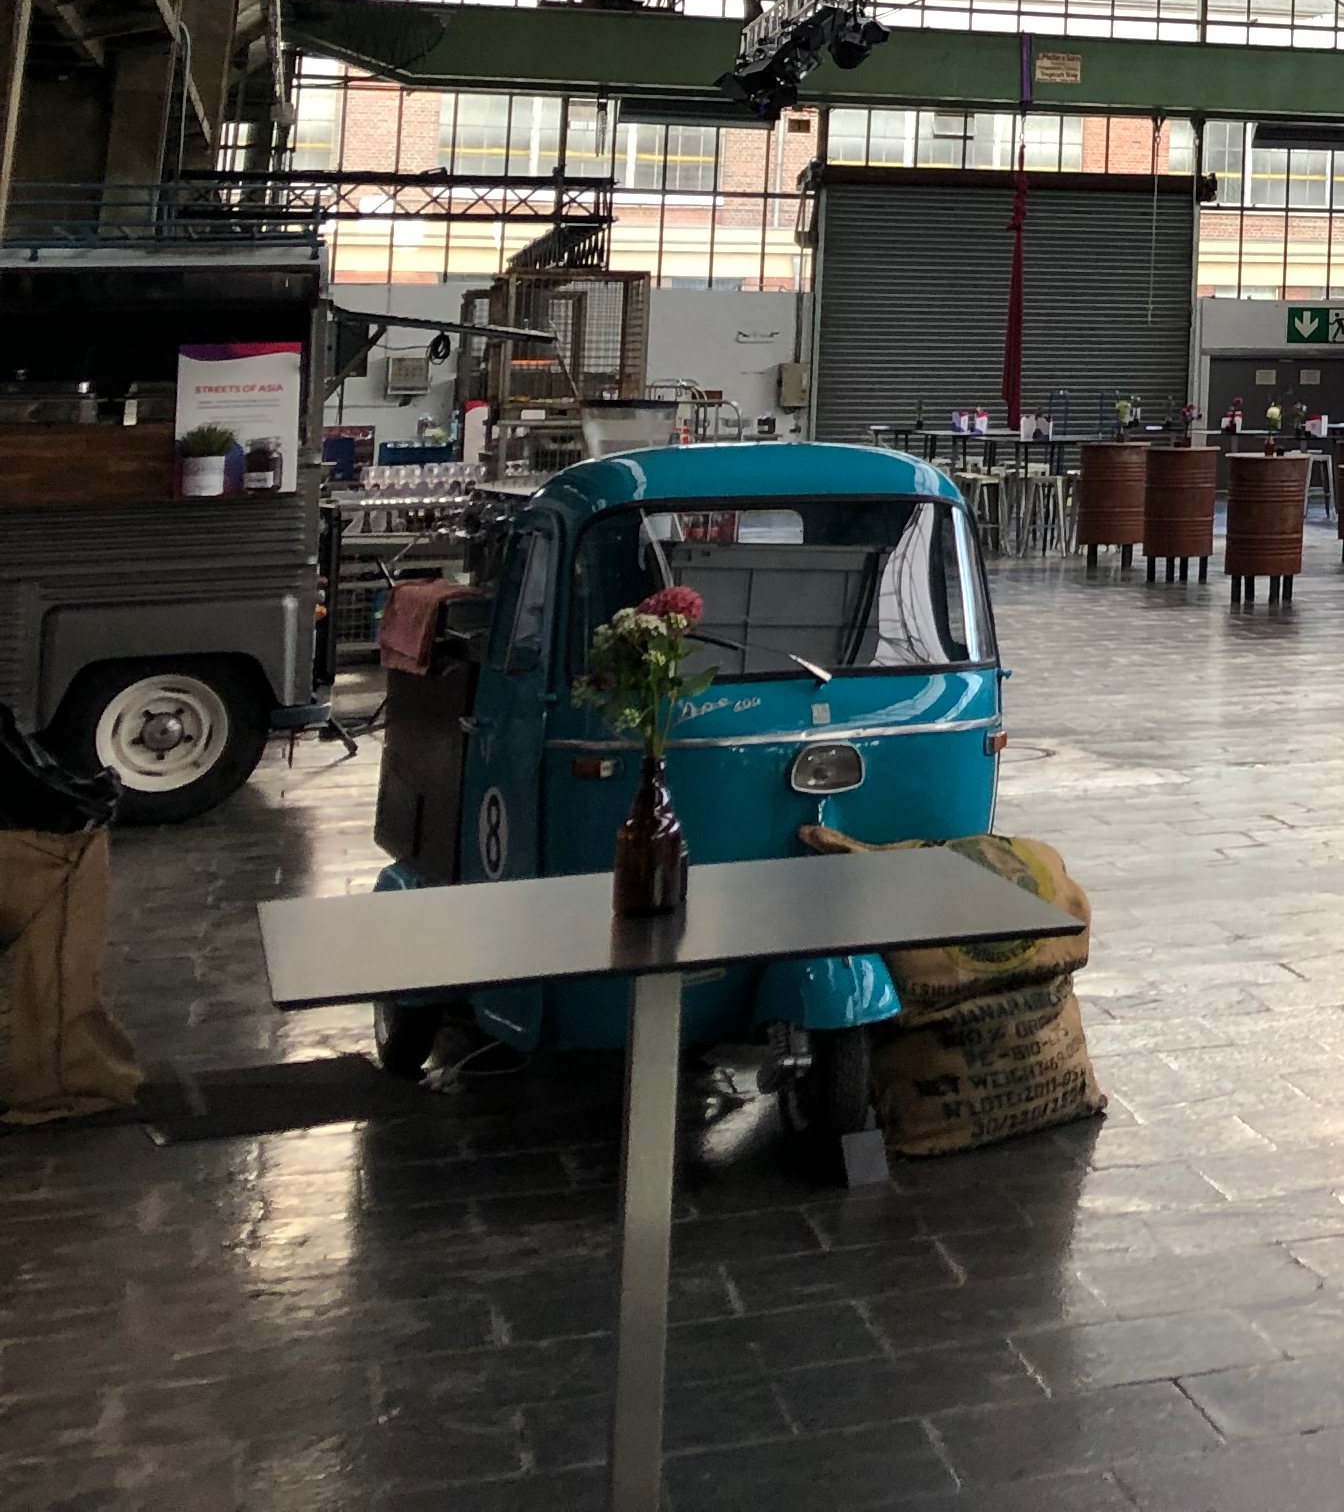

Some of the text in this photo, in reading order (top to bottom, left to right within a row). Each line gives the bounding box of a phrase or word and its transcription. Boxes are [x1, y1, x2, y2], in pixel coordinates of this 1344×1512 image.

[194, 384, 284, 394] STREETS OF ASIA
[486, 794, 501, 873] 8
